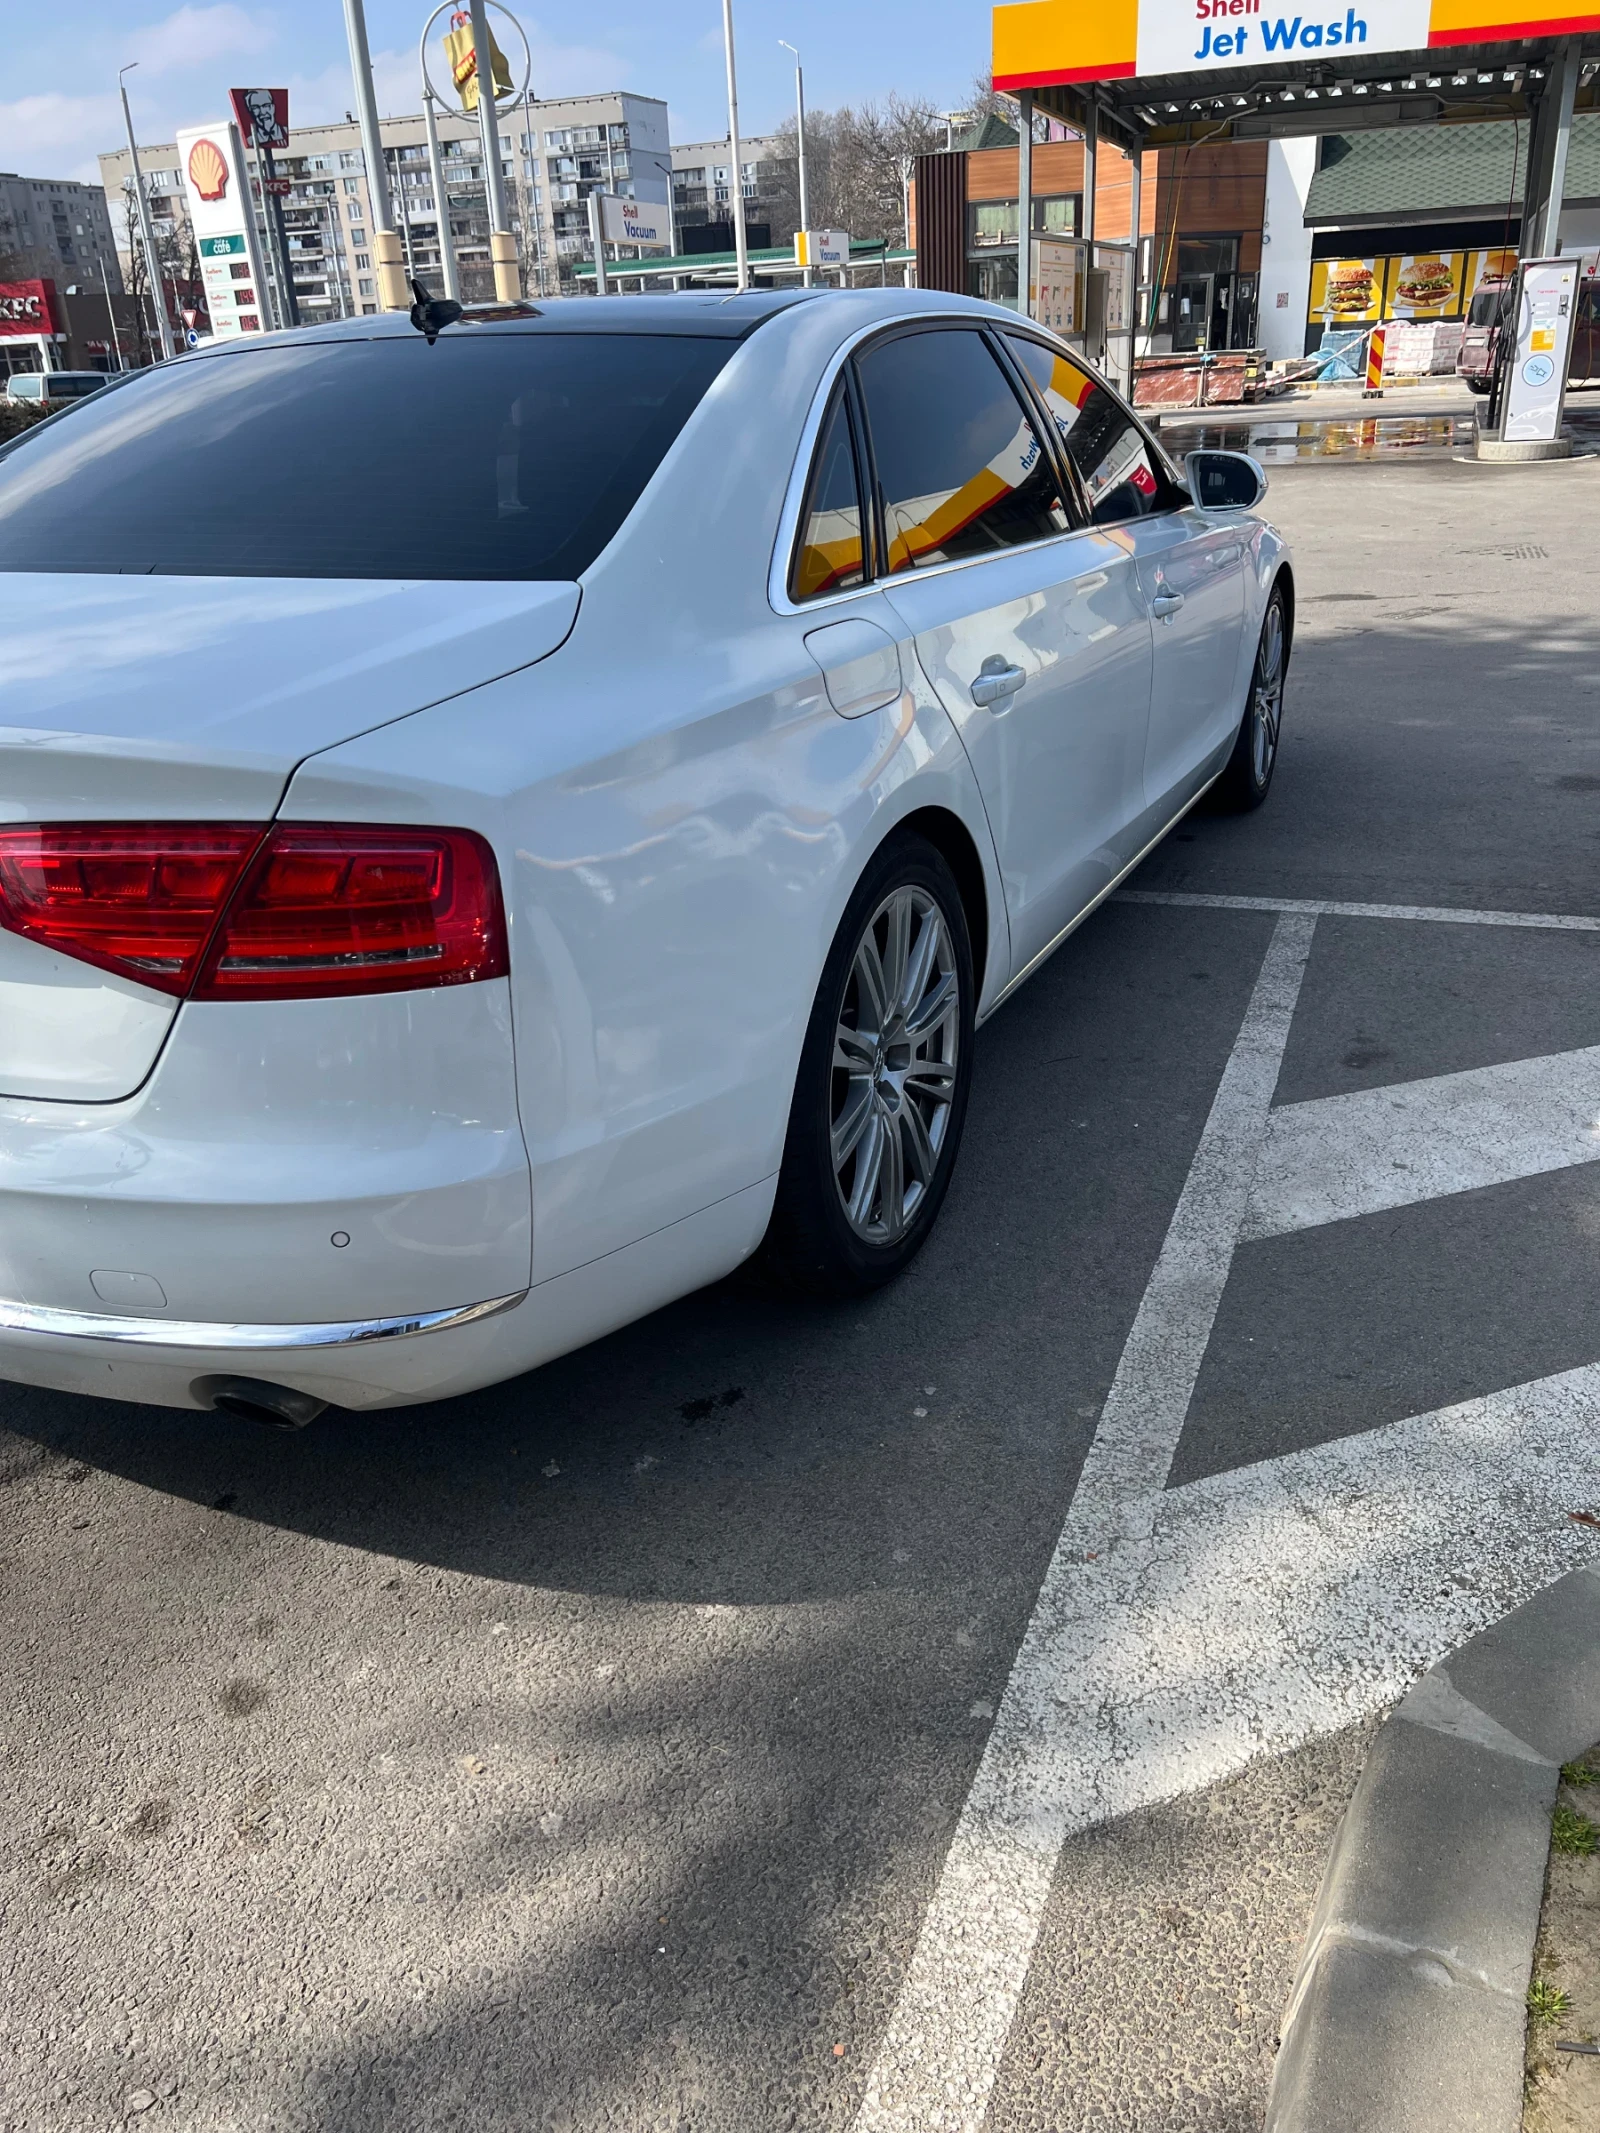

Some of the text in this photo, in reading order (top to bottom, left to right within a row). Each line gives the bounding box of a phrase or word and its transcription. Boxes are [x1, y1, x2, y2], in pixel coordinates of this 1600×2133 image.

[1196, 0, 1260, 19] Shell
[1194, 8, 1367, 59] Jet Wash
[264, 182, 288, 192] KFC
[623, 204, 638, 218] Shell
[624, 220, 657, 239] Vacuum
[820, 248, 840, 261] Vacuum
